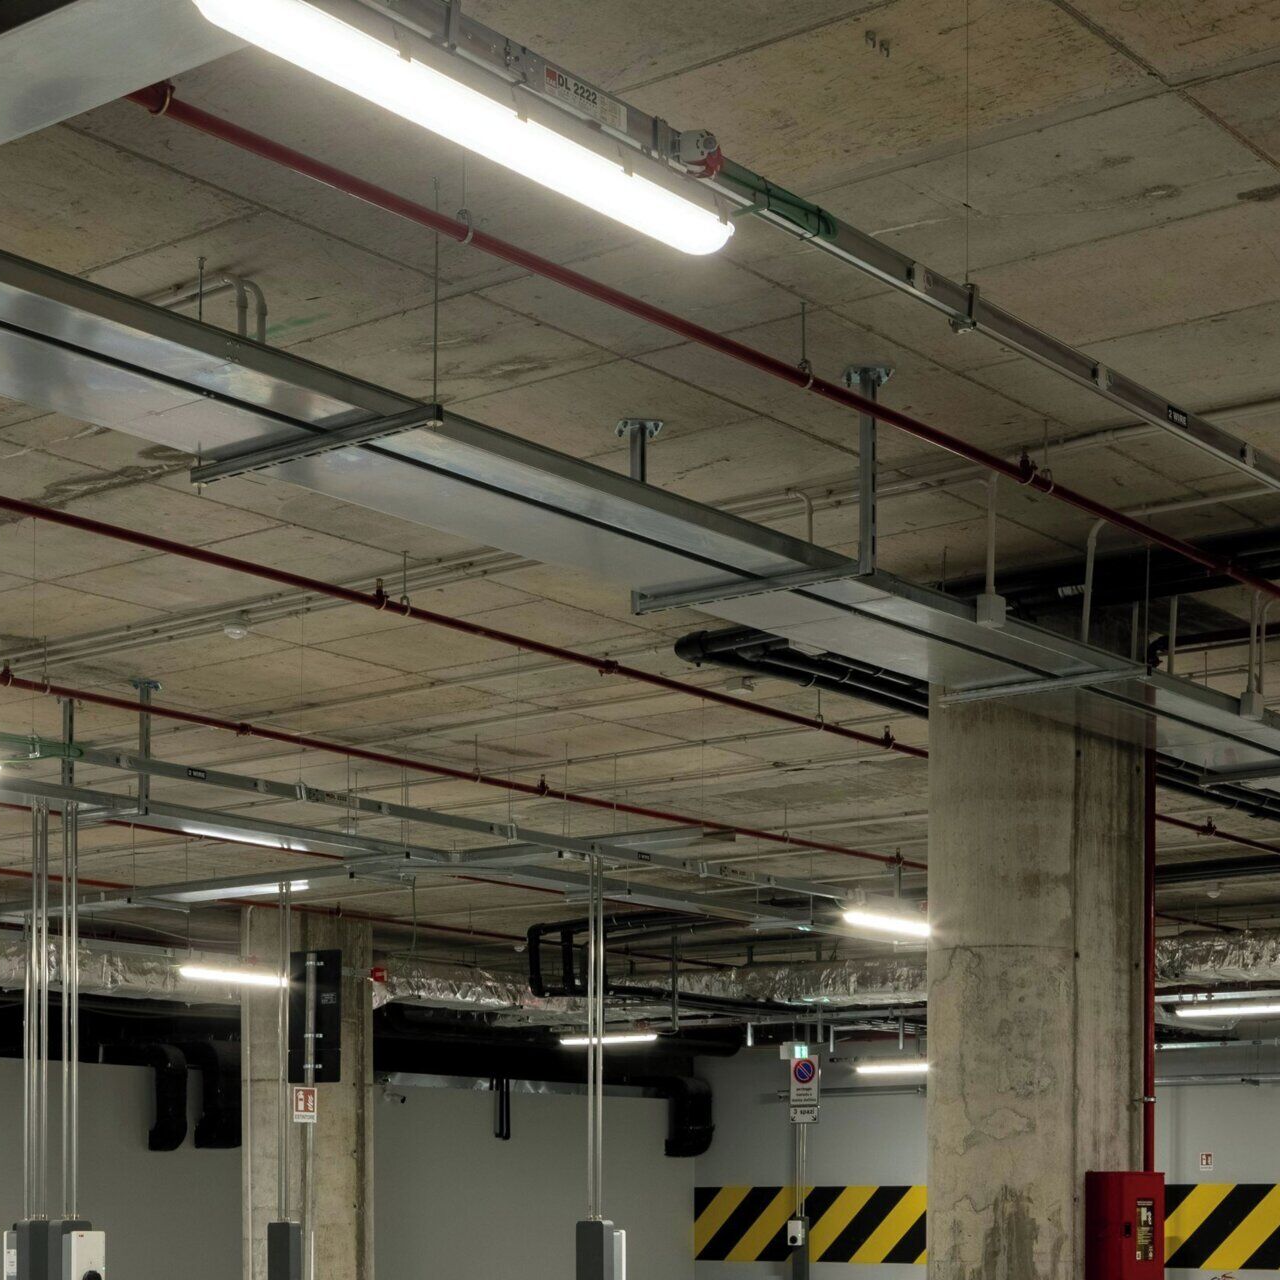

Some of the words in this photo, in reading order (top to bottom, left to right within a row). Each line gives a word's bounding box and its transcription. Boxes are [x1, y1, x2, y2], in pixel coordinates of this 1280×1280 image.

[558, 73, 571, 91] DL
[573, 82, 597, 105] 2222
[800, 1107, 815, 1115] spazi
